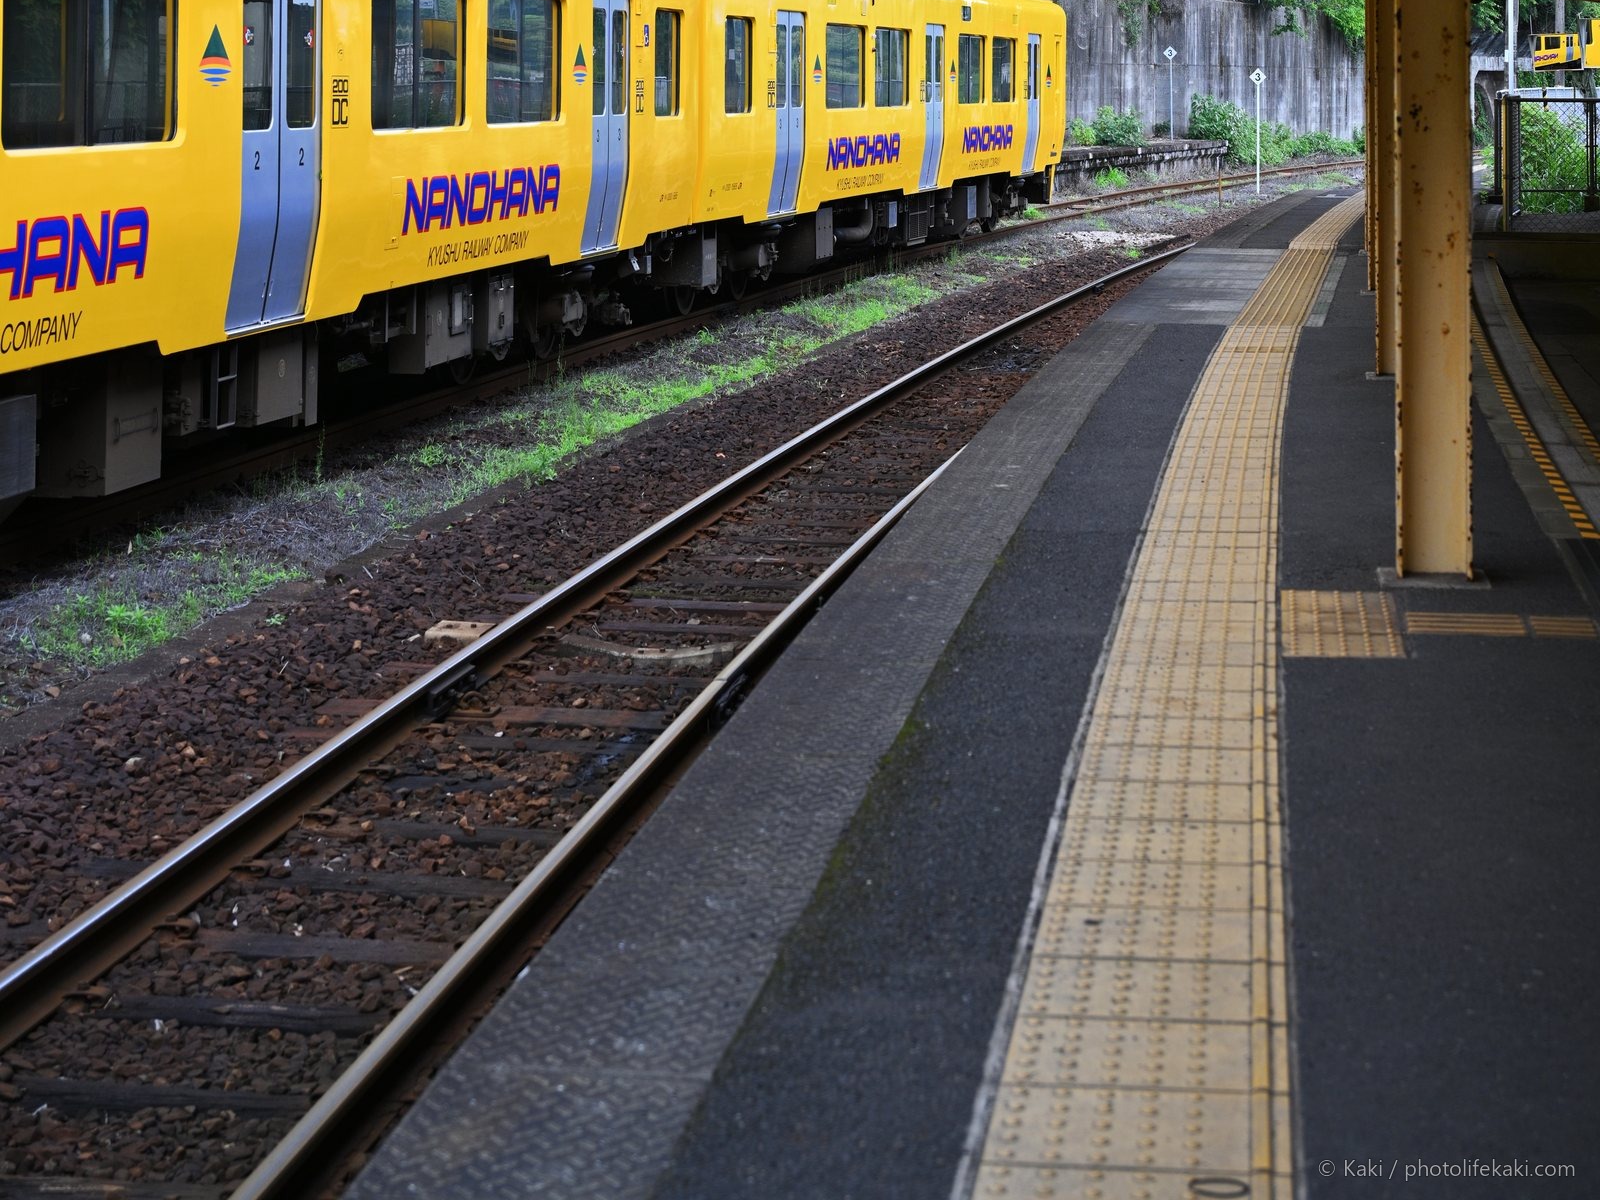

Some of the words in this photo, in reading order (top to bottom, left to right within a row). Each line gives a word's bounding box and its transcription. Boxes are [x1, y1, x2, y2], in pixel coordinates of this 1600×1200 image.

[1167, 49, 1173, 57] 3
[332, 79, 349, 93] 200
[1255, 72, 1261, 82] 3
[332, 98, 349, 125] DC
[825, 132, 901, 172] NANOHANA
[962, 124, 1014, 154] NANOHANA
[254, 150, 261, 170] 2
[299, 147, 305, 166] 2
[401, 163, 561, 236] NANOHANA
[427, 242, 462, 267] KYUSHU
[462, 236, 495, 261] RAILWAY
[494, 230, 530, 254] COMPANY
[0, 310, 83, 354] COMPANY
